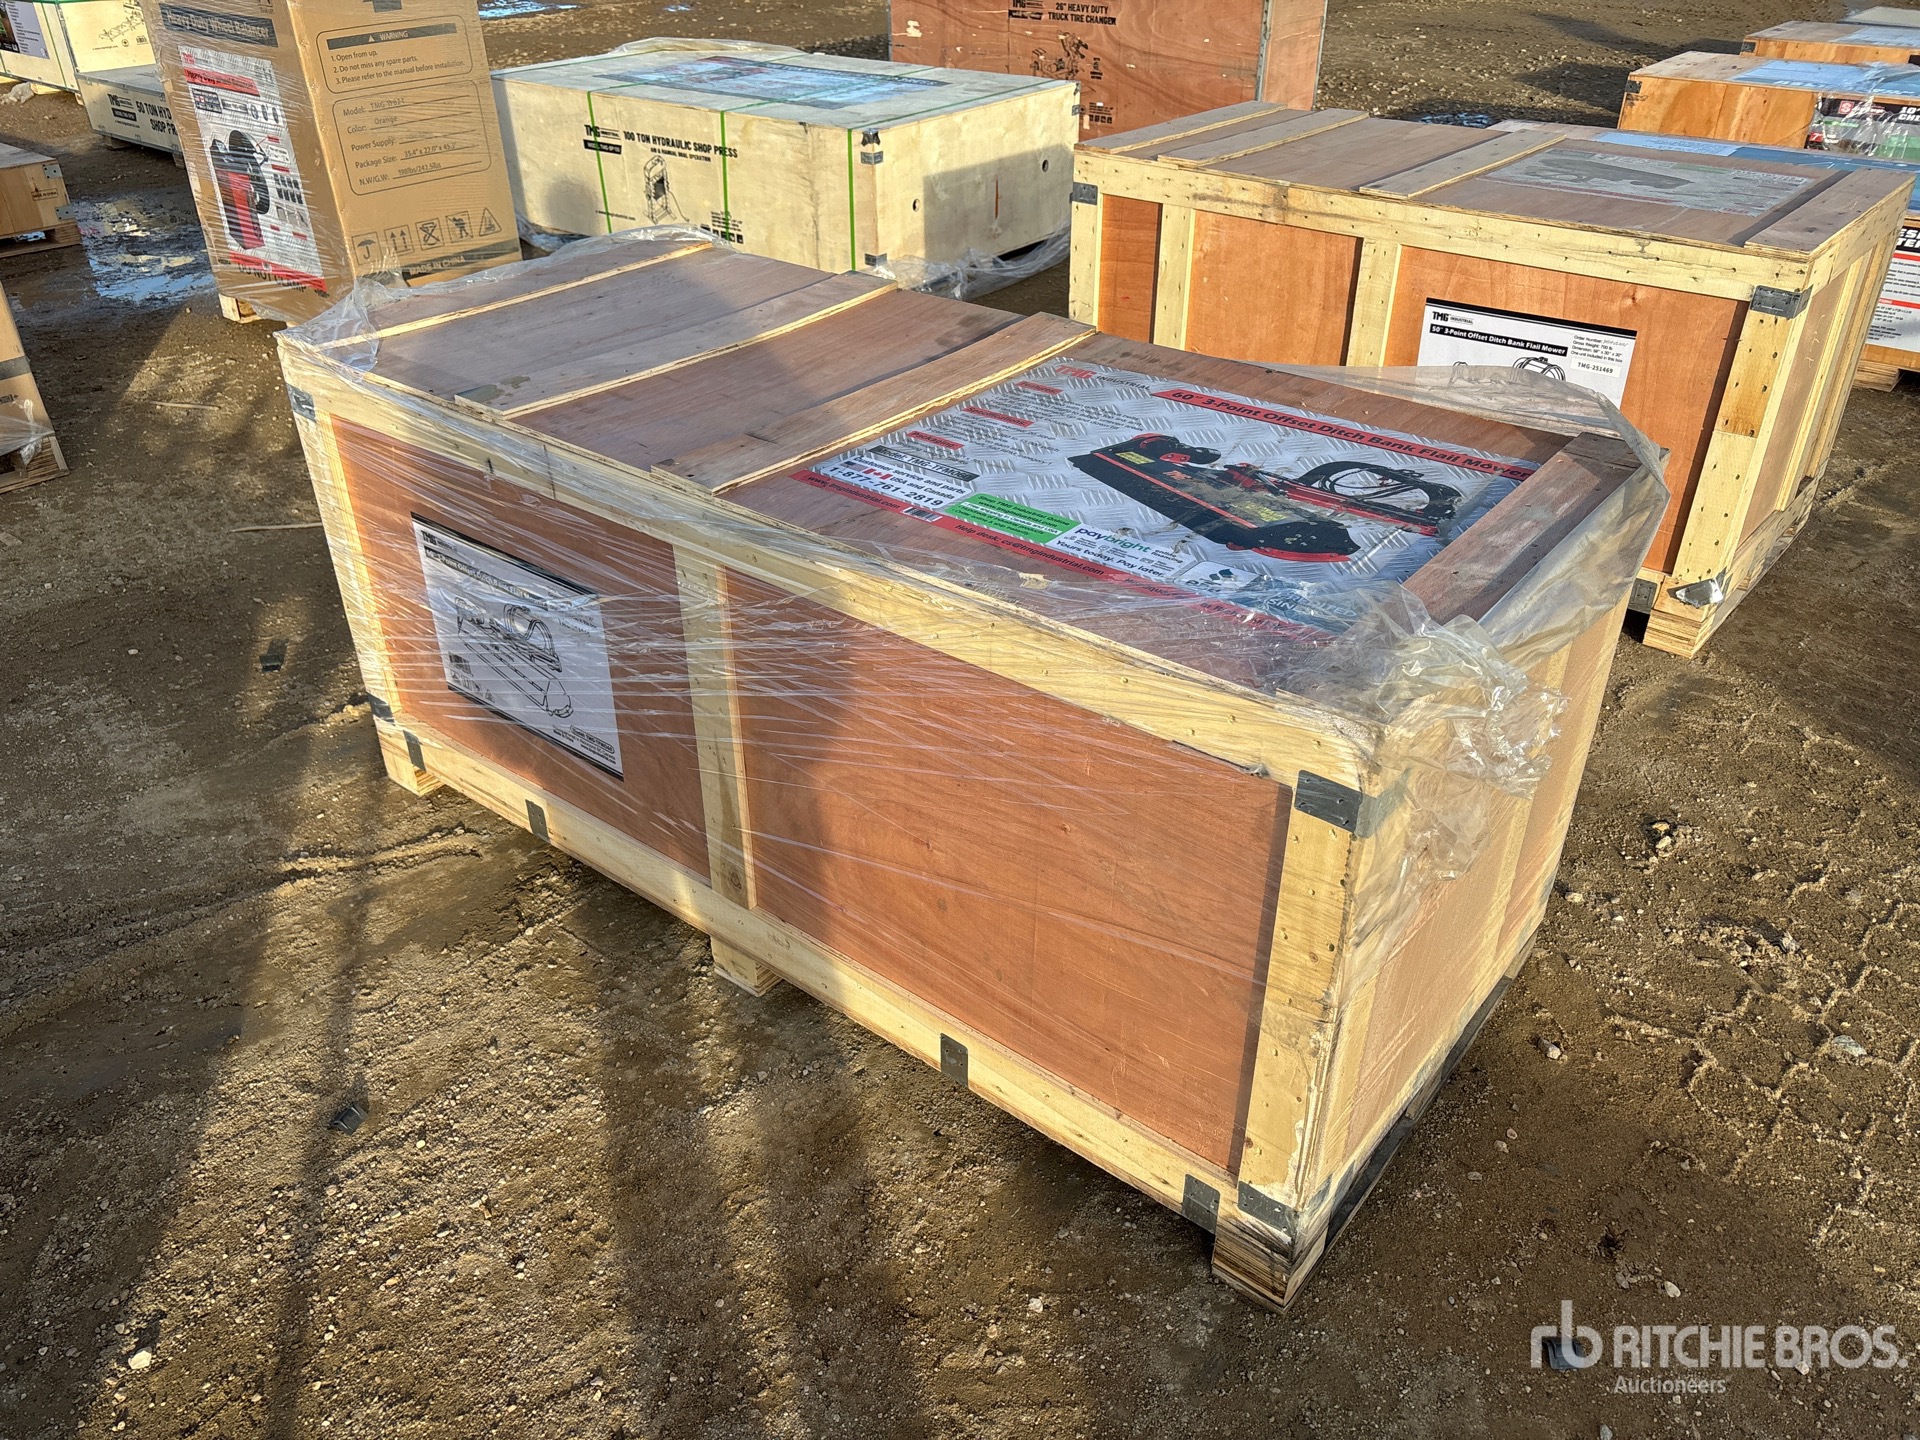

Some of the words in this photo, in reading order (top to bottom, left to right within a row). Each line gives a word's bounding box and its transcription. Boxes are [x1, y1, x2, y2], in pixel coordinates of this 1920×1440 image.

[1068, 4, 1089, 12] HEAVY
[1091, 5, 1109, 14] DUTY
[1048, 12, 1069, 20] TRUCK
[1070, 14, 1084, 22] TIRE
[1085, 15, 1117, 25] CHANGER
[380, 31, 408, 41] WARNING
[336, 53, 352, 62] Open
[353, 50, 368, 59] from
[350, 63, 360, 71] not
[374, 60, 385, 68] any
[386, 58, 402, 67] spare
[402, 56, 418, 65] parts.
[342, 73, 361, 83] Please
[361, 72, 376, 80] refer
[383, 69, 393, 77] the
[394, 67, 415, 75] manual
[415, 64, 434, 73] before
[135, 101, 146, 113] 50
[144, 103, 159, 117] TON
[343, 106, 366, 116] Model:
[149, 119, 166, 133] SHOP
[347, 125, 367, 134] Color:
[374, 116, 398, 125] Orange
[351, 141, 371, 151] Power
[373, 138, 396, 149] Supply:
[623, 131, 635, 141] 100
[636, 133, 650, 144] TON
[652, 136, 692, 150] HYDRAULIC
[693, 142, 712, 154] SHOP
[714, 146, 738, 158] PRESS
[355, 159, 382, 169] Package
[382, 156, 397, 166] Size:
[409, 263, 432, 275] MADE
[442, 255, 466, 267] CHINA
[254, 269, 273, 280] NOT
[1432, 311, 1449, 322] TMG
[1444, 327, 1467, 338] 3-Point
[1467, 332, 1488, 341] Offset
[1489, 335, 1506, 344] Ditch
[1507, 339, 1525, 347] Bank
[1525, 342, 1541, 351] Flail
[1541, 344, 1566, 354] Mower
[1578, 362, 1613, 374] TMG-251469
[1055, 365, 1097, 379] TMG
[1097, 375, 1151, 391] INDUSTRIAL
[1202, 398, 1263, 417] 3-Point
[1263, 412, 1317, 430] Offset
[1317, 424, 1365, 441] Ditch
[1367, 436, 1414, 453] Bank
[1419, 448, 1459, 463] Flail
[1462, 457, 1533, 479] Mower
[880, 449, 906, 463] Model:
[853, 455, 892, 472] Customer
[894, 467, 924, 481] service
[924, 475, 942, 486] and
[942, 484, 967, 496] parts
[808, 476, 900, 510] www.tmgindustrial.com
[829, 466, 943, 507] 1-877-761-2819
[890, 476, 908, 487] USA
[909, 482, 923, 492] and
[924, 487, 955, 499] Canada
[997, 501, 1013, 509] TMG
[1013, 506, 1047, 520] Industrial
[1047, 516, 1070, 526] Online
[954, 524, 976, 535] Help
[976, 531, 1000, 543] desk:
[1001, 539, 1105, 576] cs@tmgindustrial.com
[1075, 527, 1151, 553] paybright
[1154, 550, 1177, 558] online
[1056, 540, 1081, 552] Yours
[1083, 549, 1115, 563] today.
[1117, 559, 1137, 570] Pay
[1138, 565, 1165, 578] later.
[1150, 552, 1183, 564] financing
